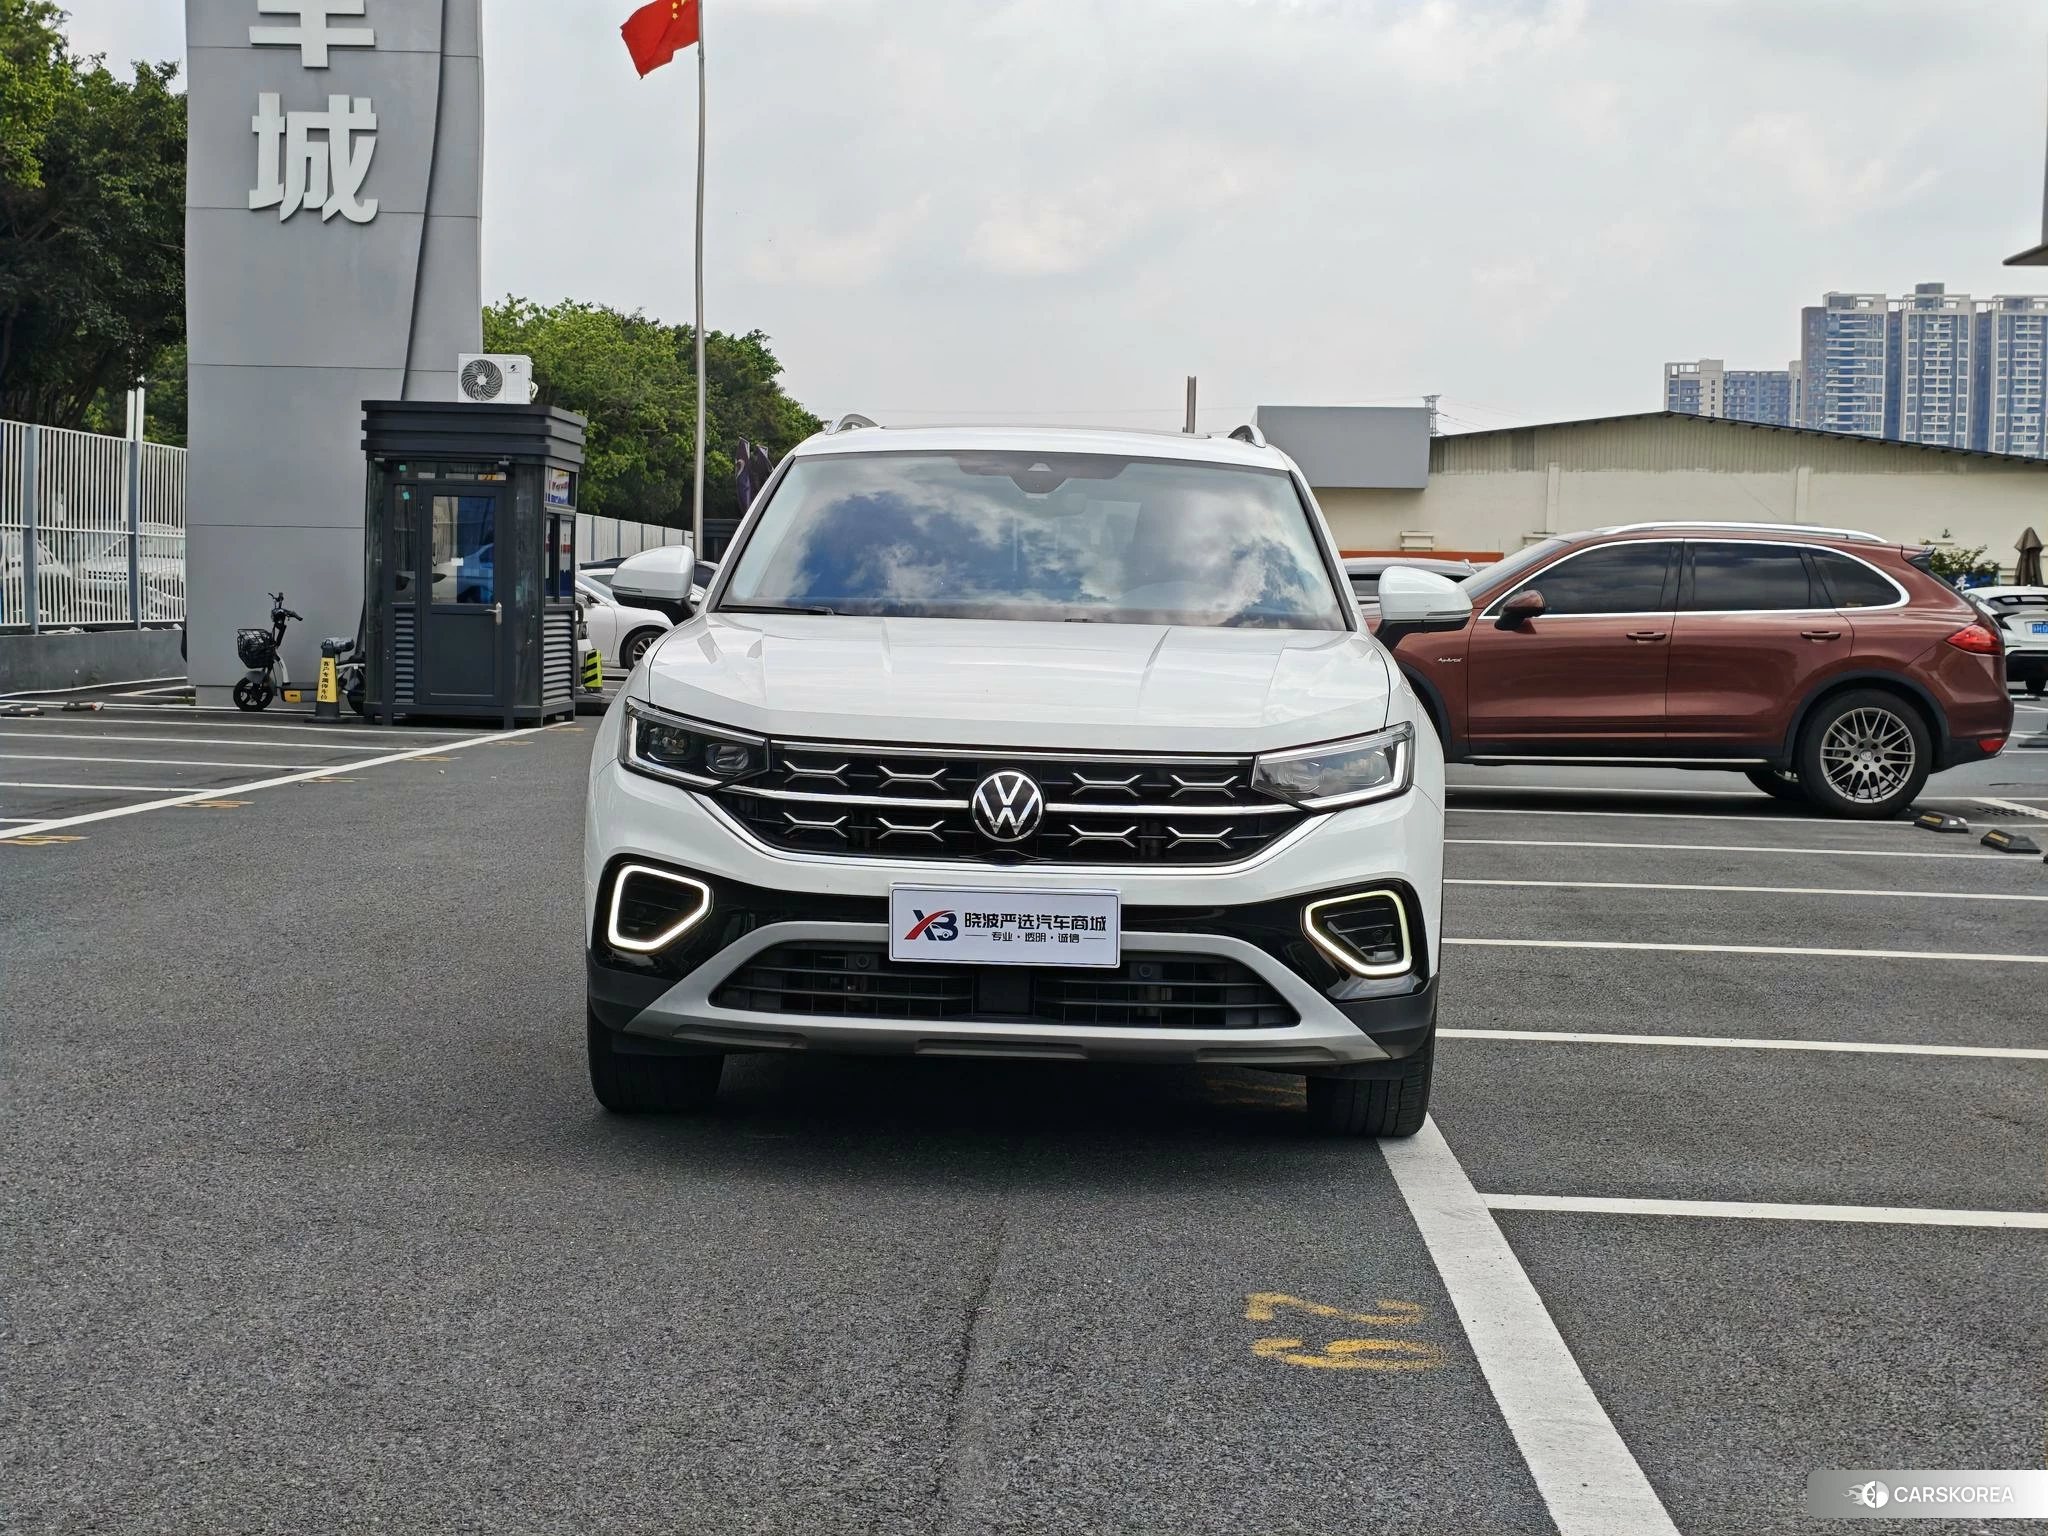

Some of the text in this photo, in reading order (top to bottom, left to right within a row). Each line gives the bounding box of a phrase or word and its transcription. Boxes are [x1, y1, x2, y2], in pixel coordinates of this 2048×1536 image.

[965, 912, 1106, 931] 晓波严选汽车商城
